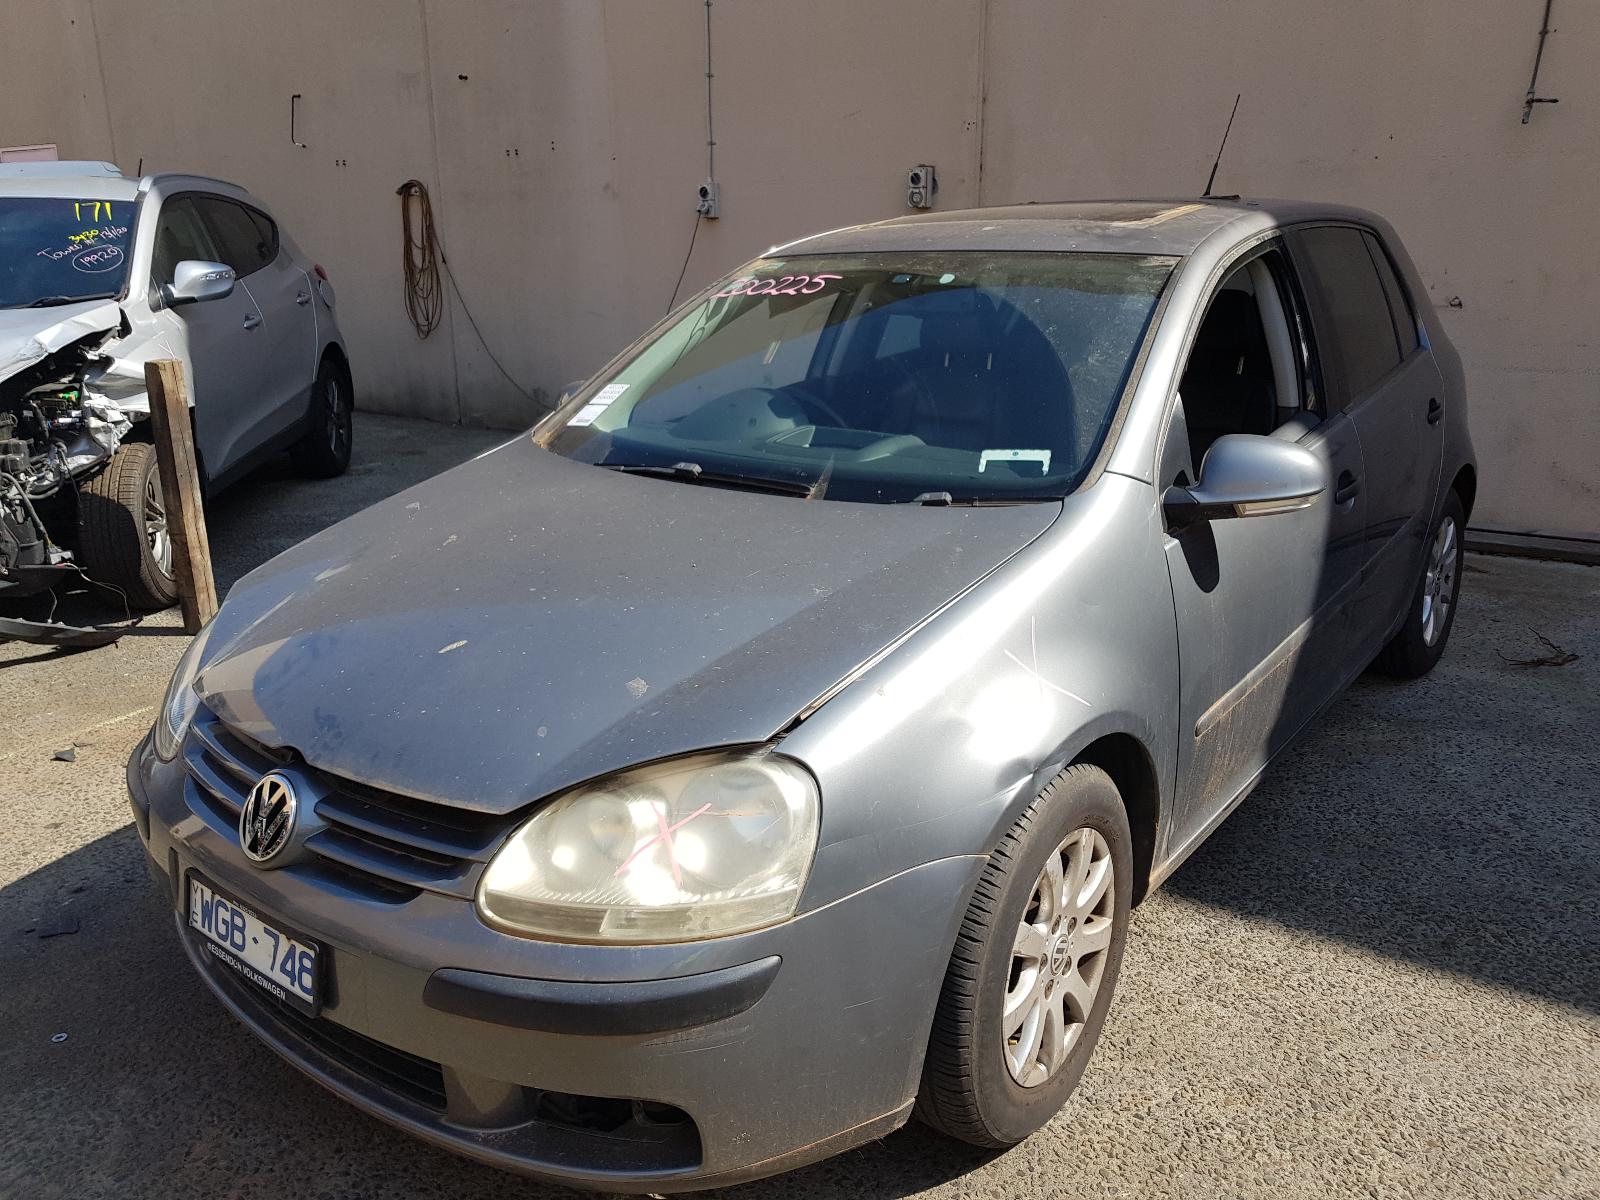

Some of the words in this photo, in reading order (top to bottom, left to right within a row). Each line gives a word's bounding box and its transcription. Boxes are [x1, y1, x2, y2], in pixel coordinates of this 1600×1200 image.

[74, 202, 112, 223] 171
[211, 944, 242, 972] ESSENDON
[241, 965, 286, 1000] VOLKSWAGEN
